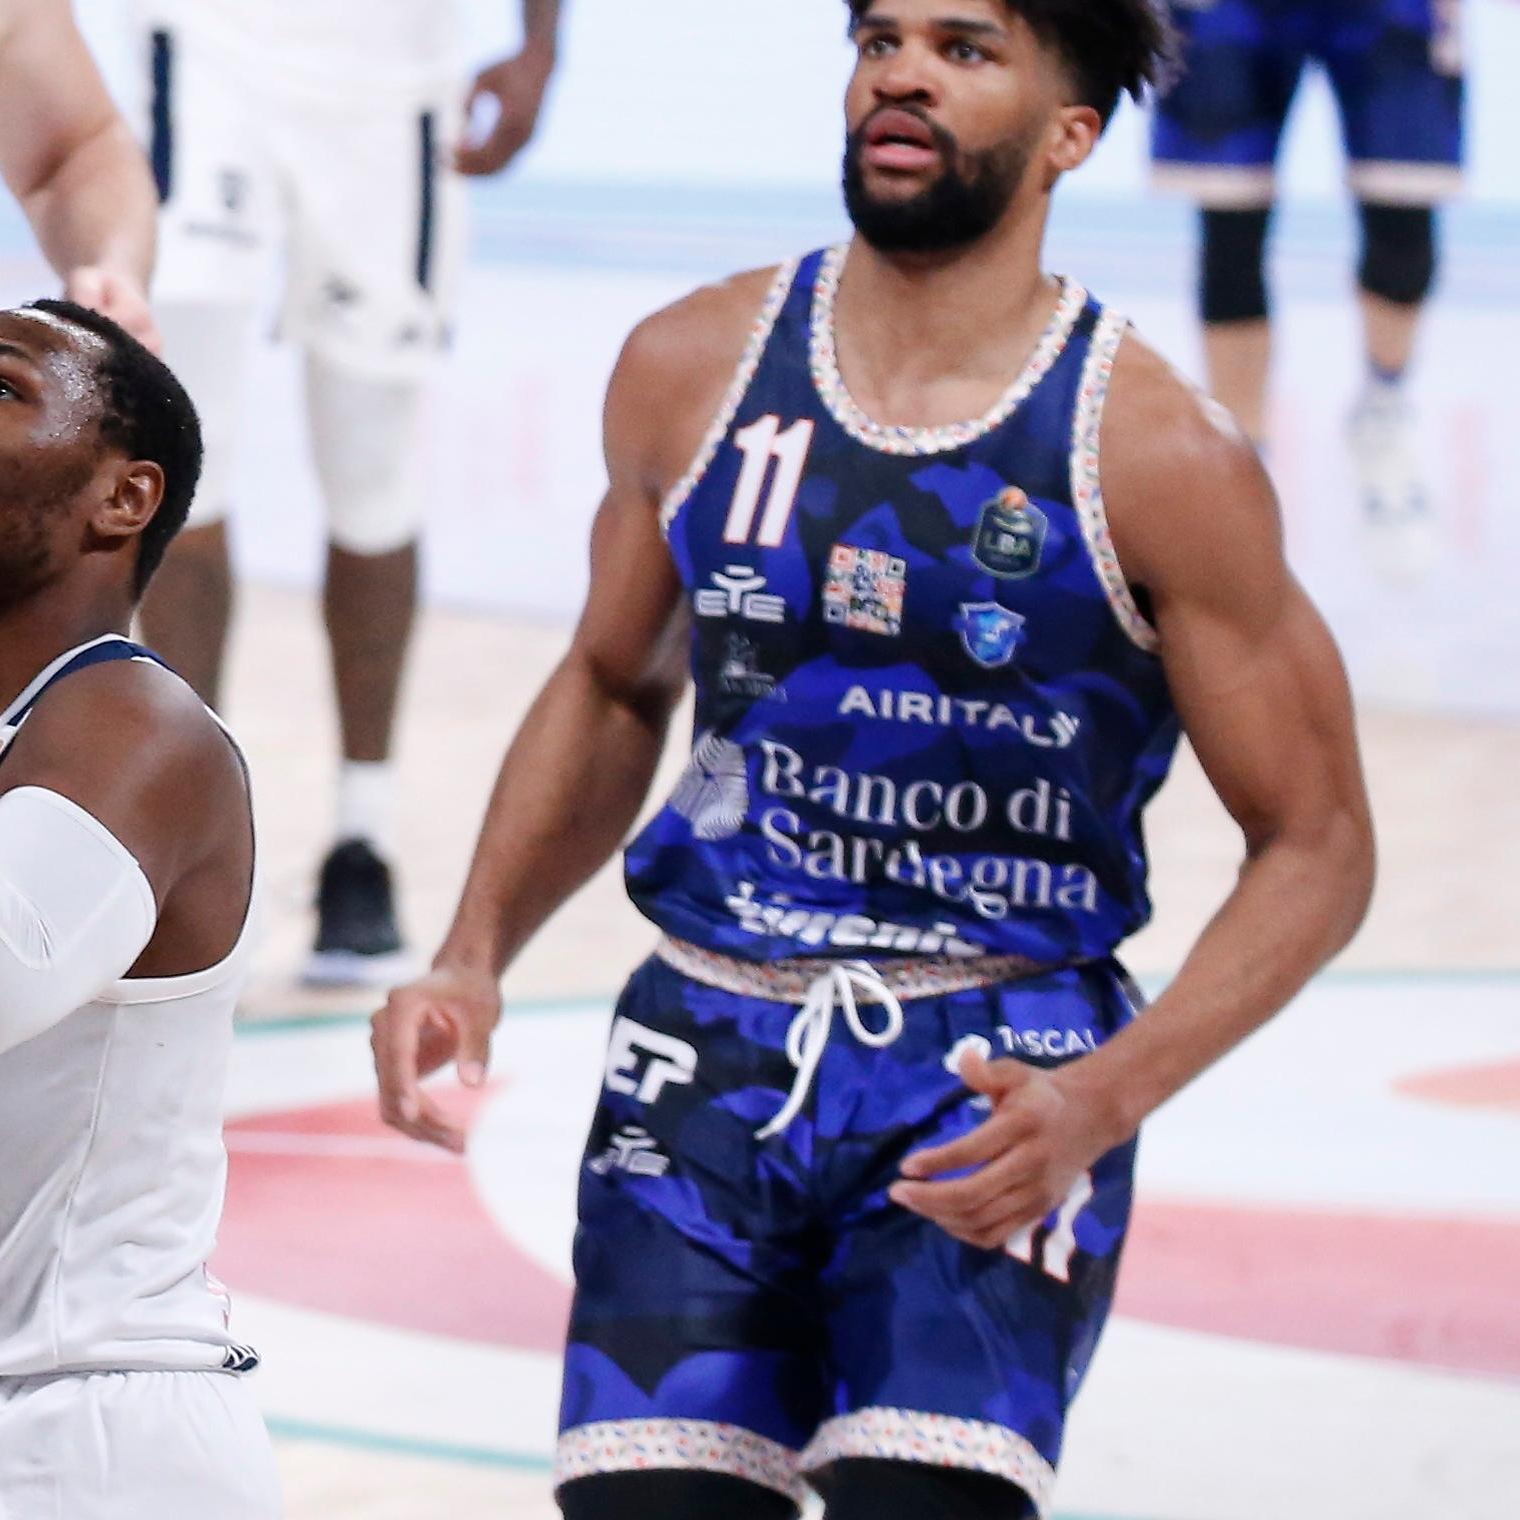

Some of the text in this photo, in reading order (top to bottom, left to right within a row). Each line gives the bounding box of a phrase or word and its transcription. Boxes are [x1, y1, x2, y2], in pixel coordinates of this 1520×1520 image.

[721, 412, 816, 549] 11
[838, 684, 1082, 748] AIRITALY
[760, 736, 1074, 841] Banco di
[760, 806, 1099, 920] Sardegna
